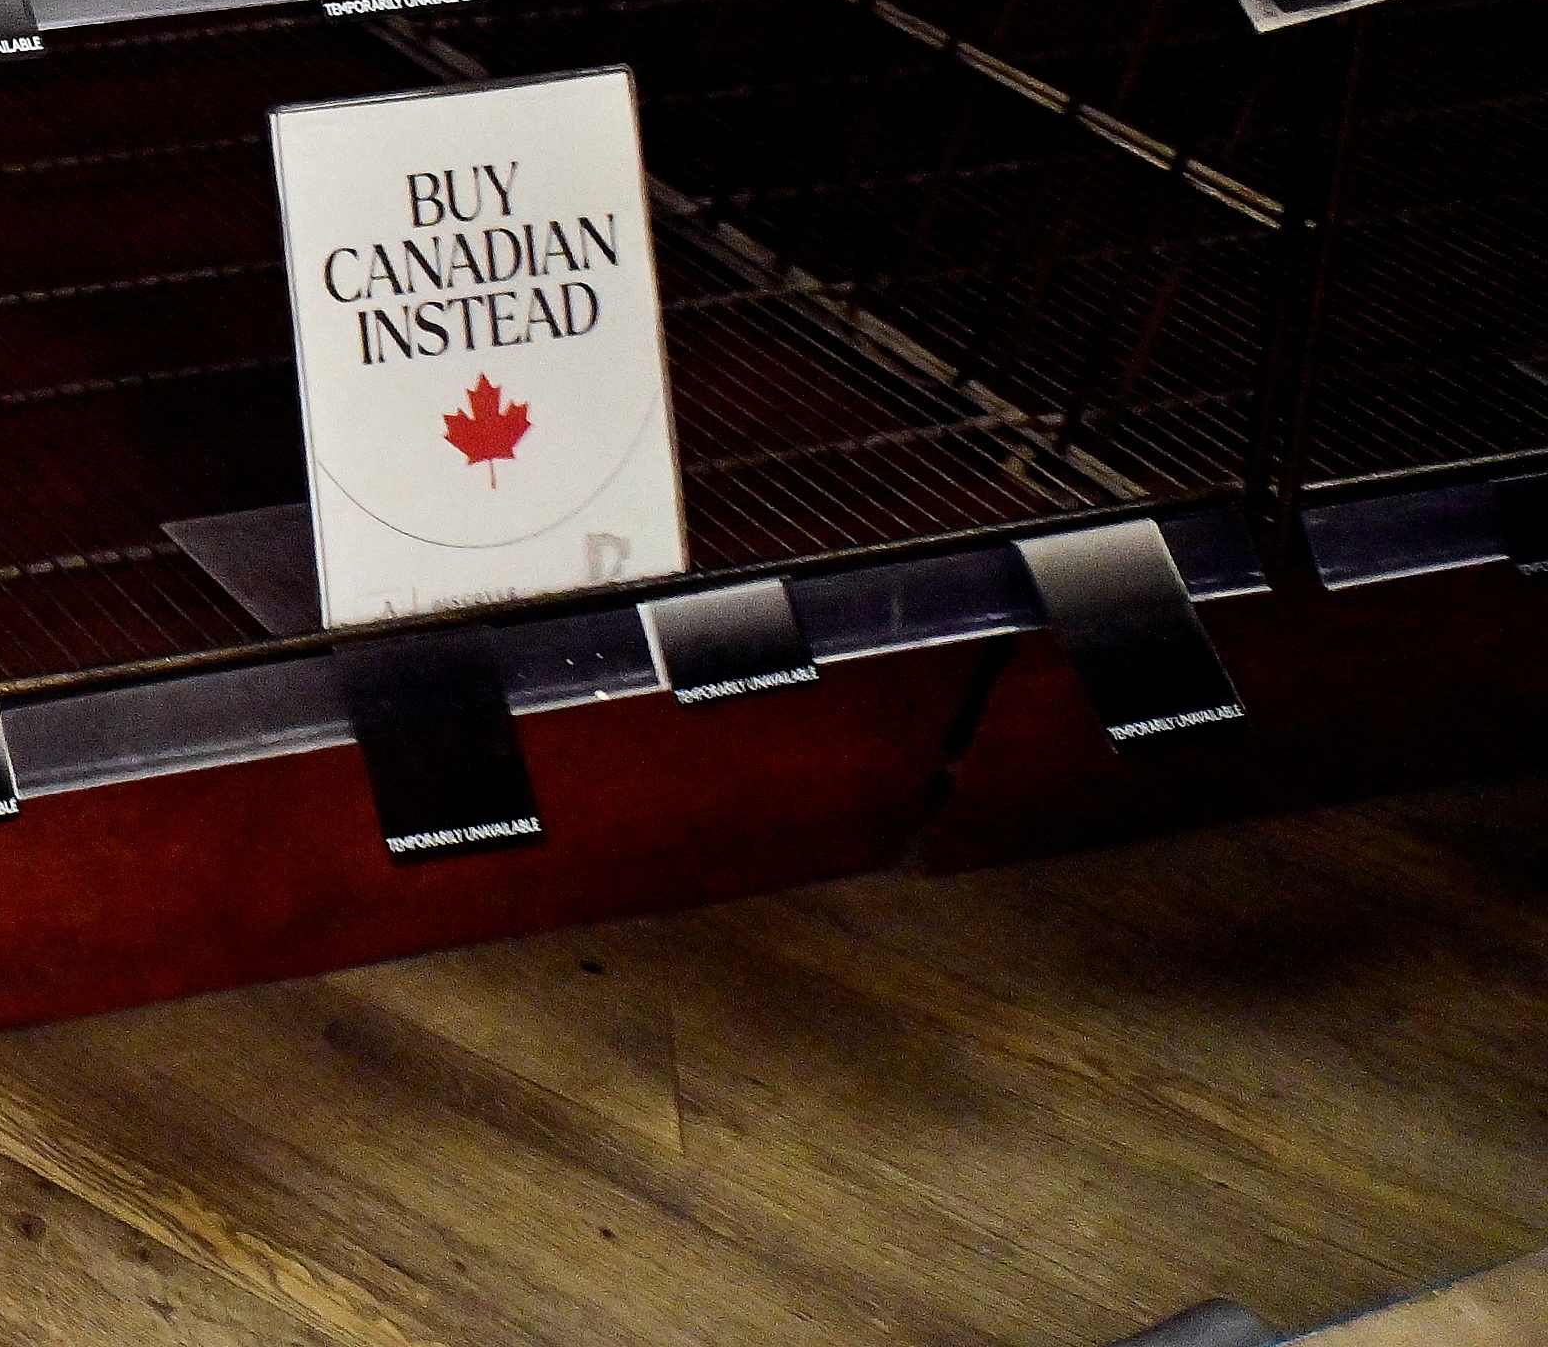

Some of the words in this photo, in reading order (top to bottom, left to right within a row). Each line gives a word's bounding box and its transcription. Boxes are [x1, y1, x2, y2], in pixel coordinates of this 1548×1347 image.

[406, 161, 519, 228] BUY
[323, 213, 619, 304] CANADIAN
[356, 281, 599, 366] INSTEAD
